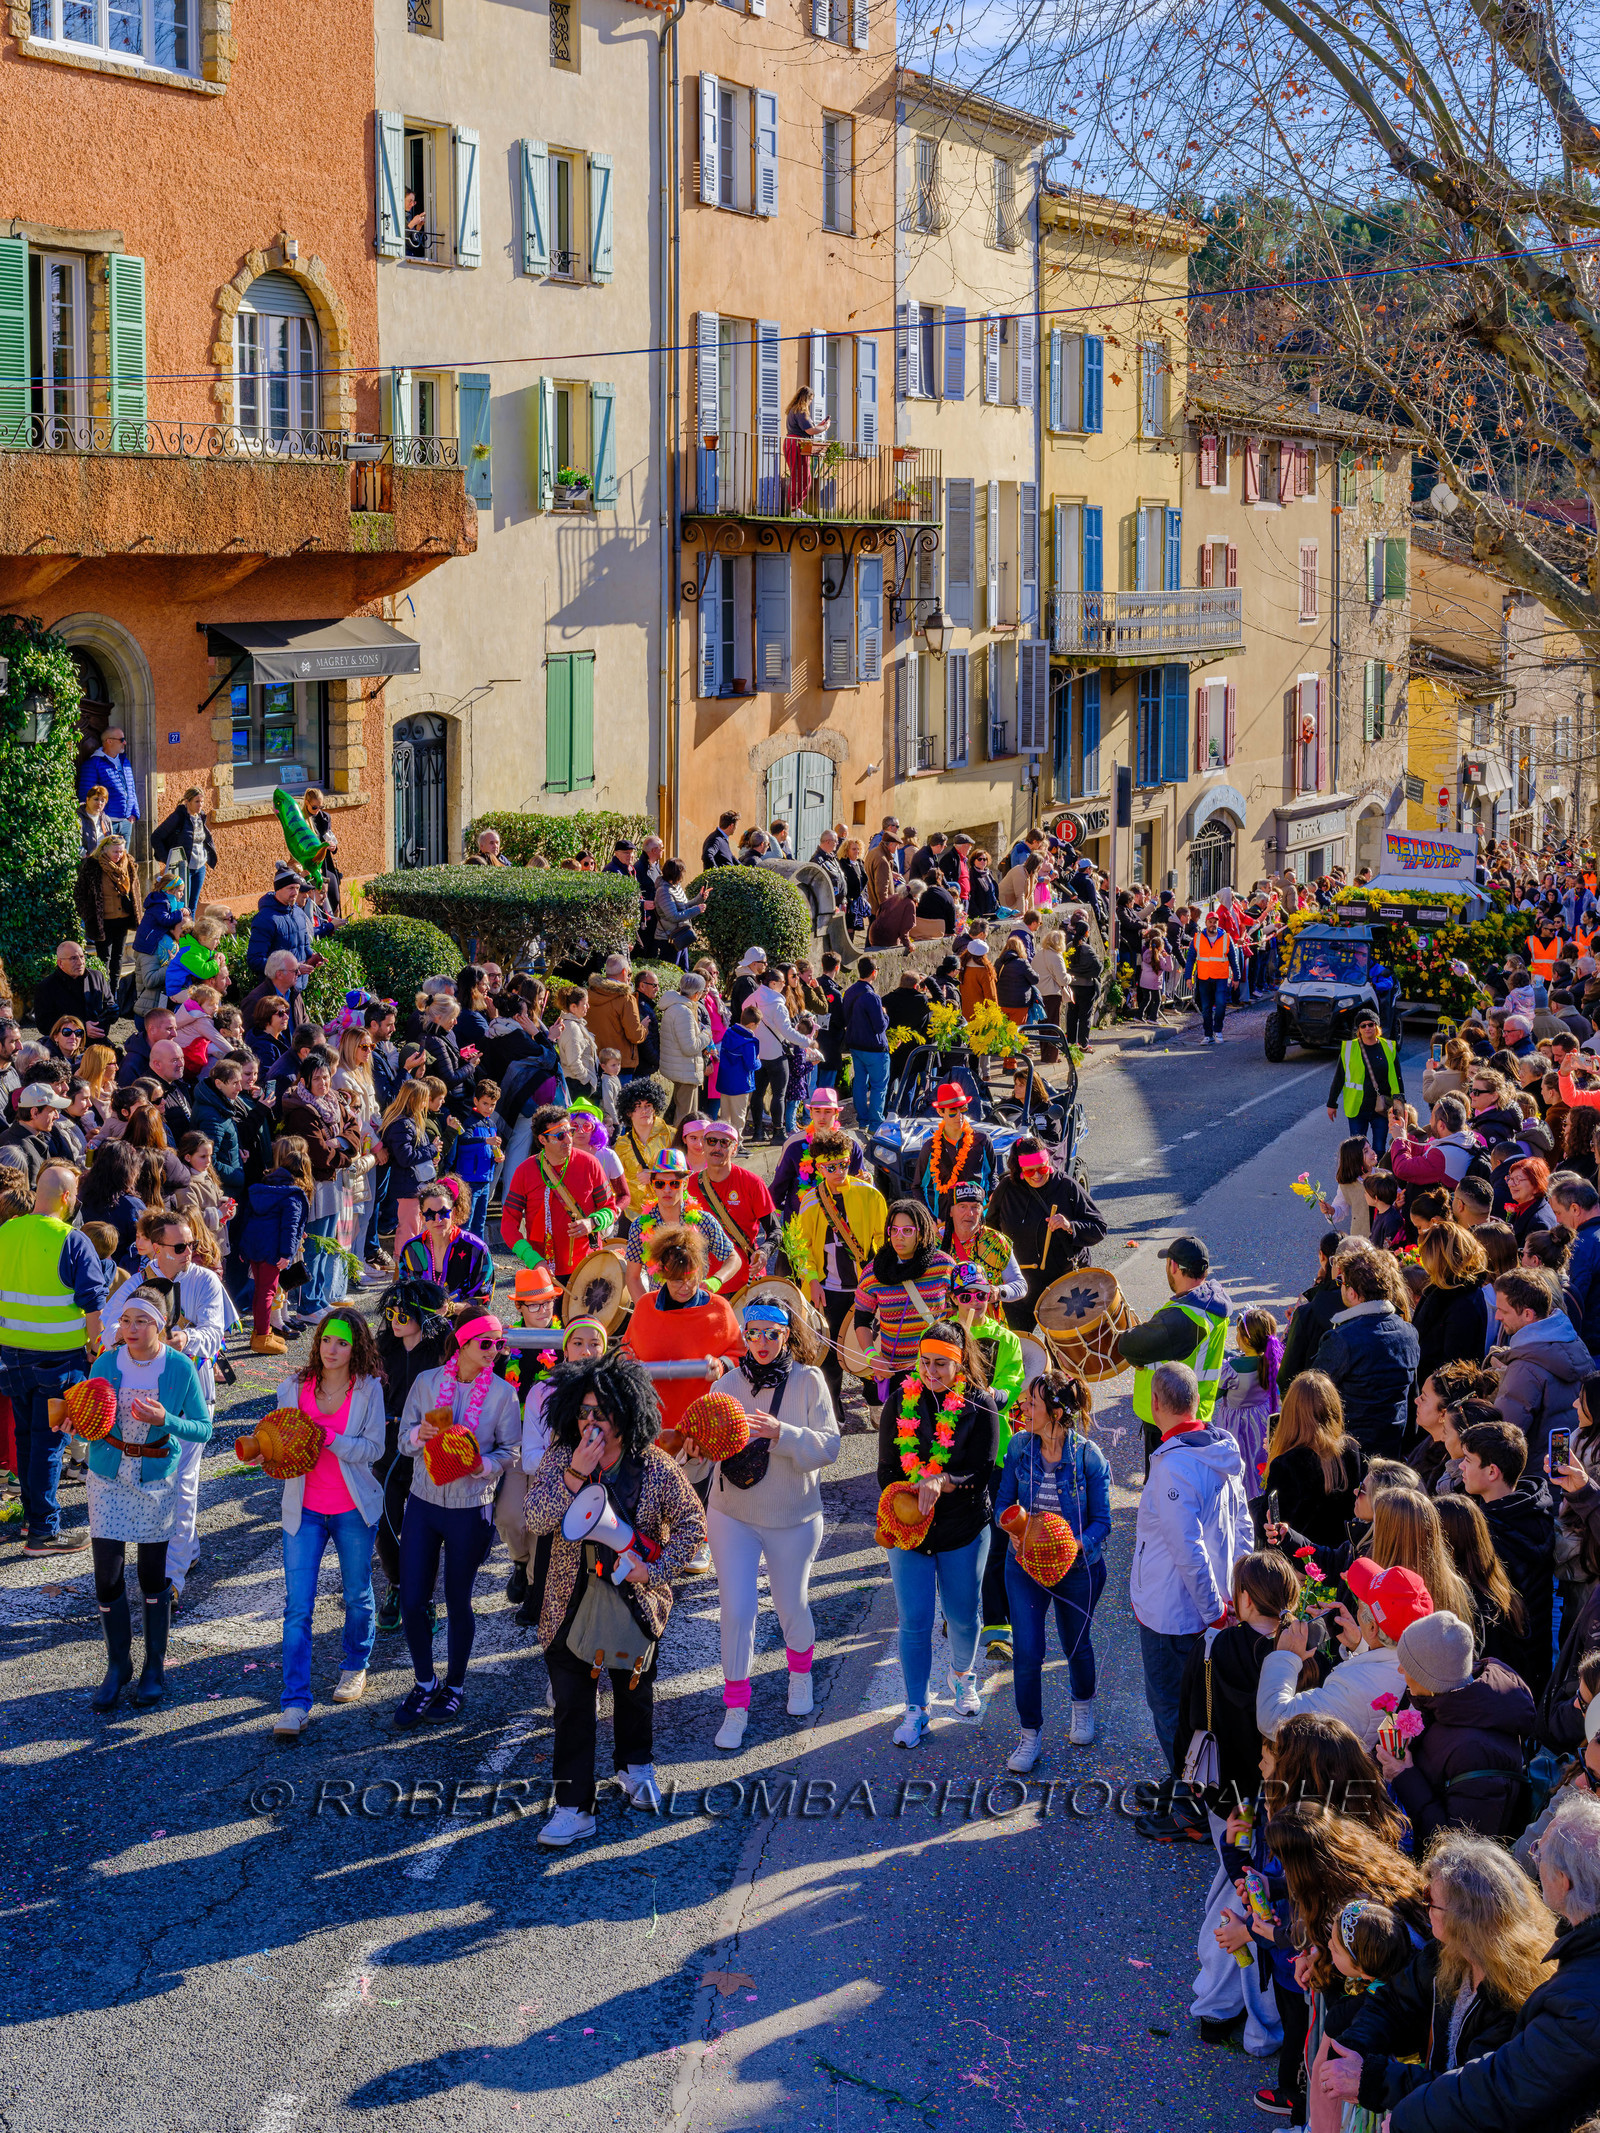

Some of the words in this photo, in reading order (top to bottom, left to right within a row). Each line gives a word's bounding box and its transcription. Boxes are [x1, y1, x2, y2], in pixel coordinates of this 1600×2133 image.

[316, 656, 349, 667] MAGREY
[351, 656, 357, 665] &
[359, 654, 379, 664] SONS
[171, 734, 179, 742] 27
[1386, 834, 1461, 857] RETOUR
[1413, 855, 1462, 869] FUTUR
[1418, 935, 1427, 948] 5
